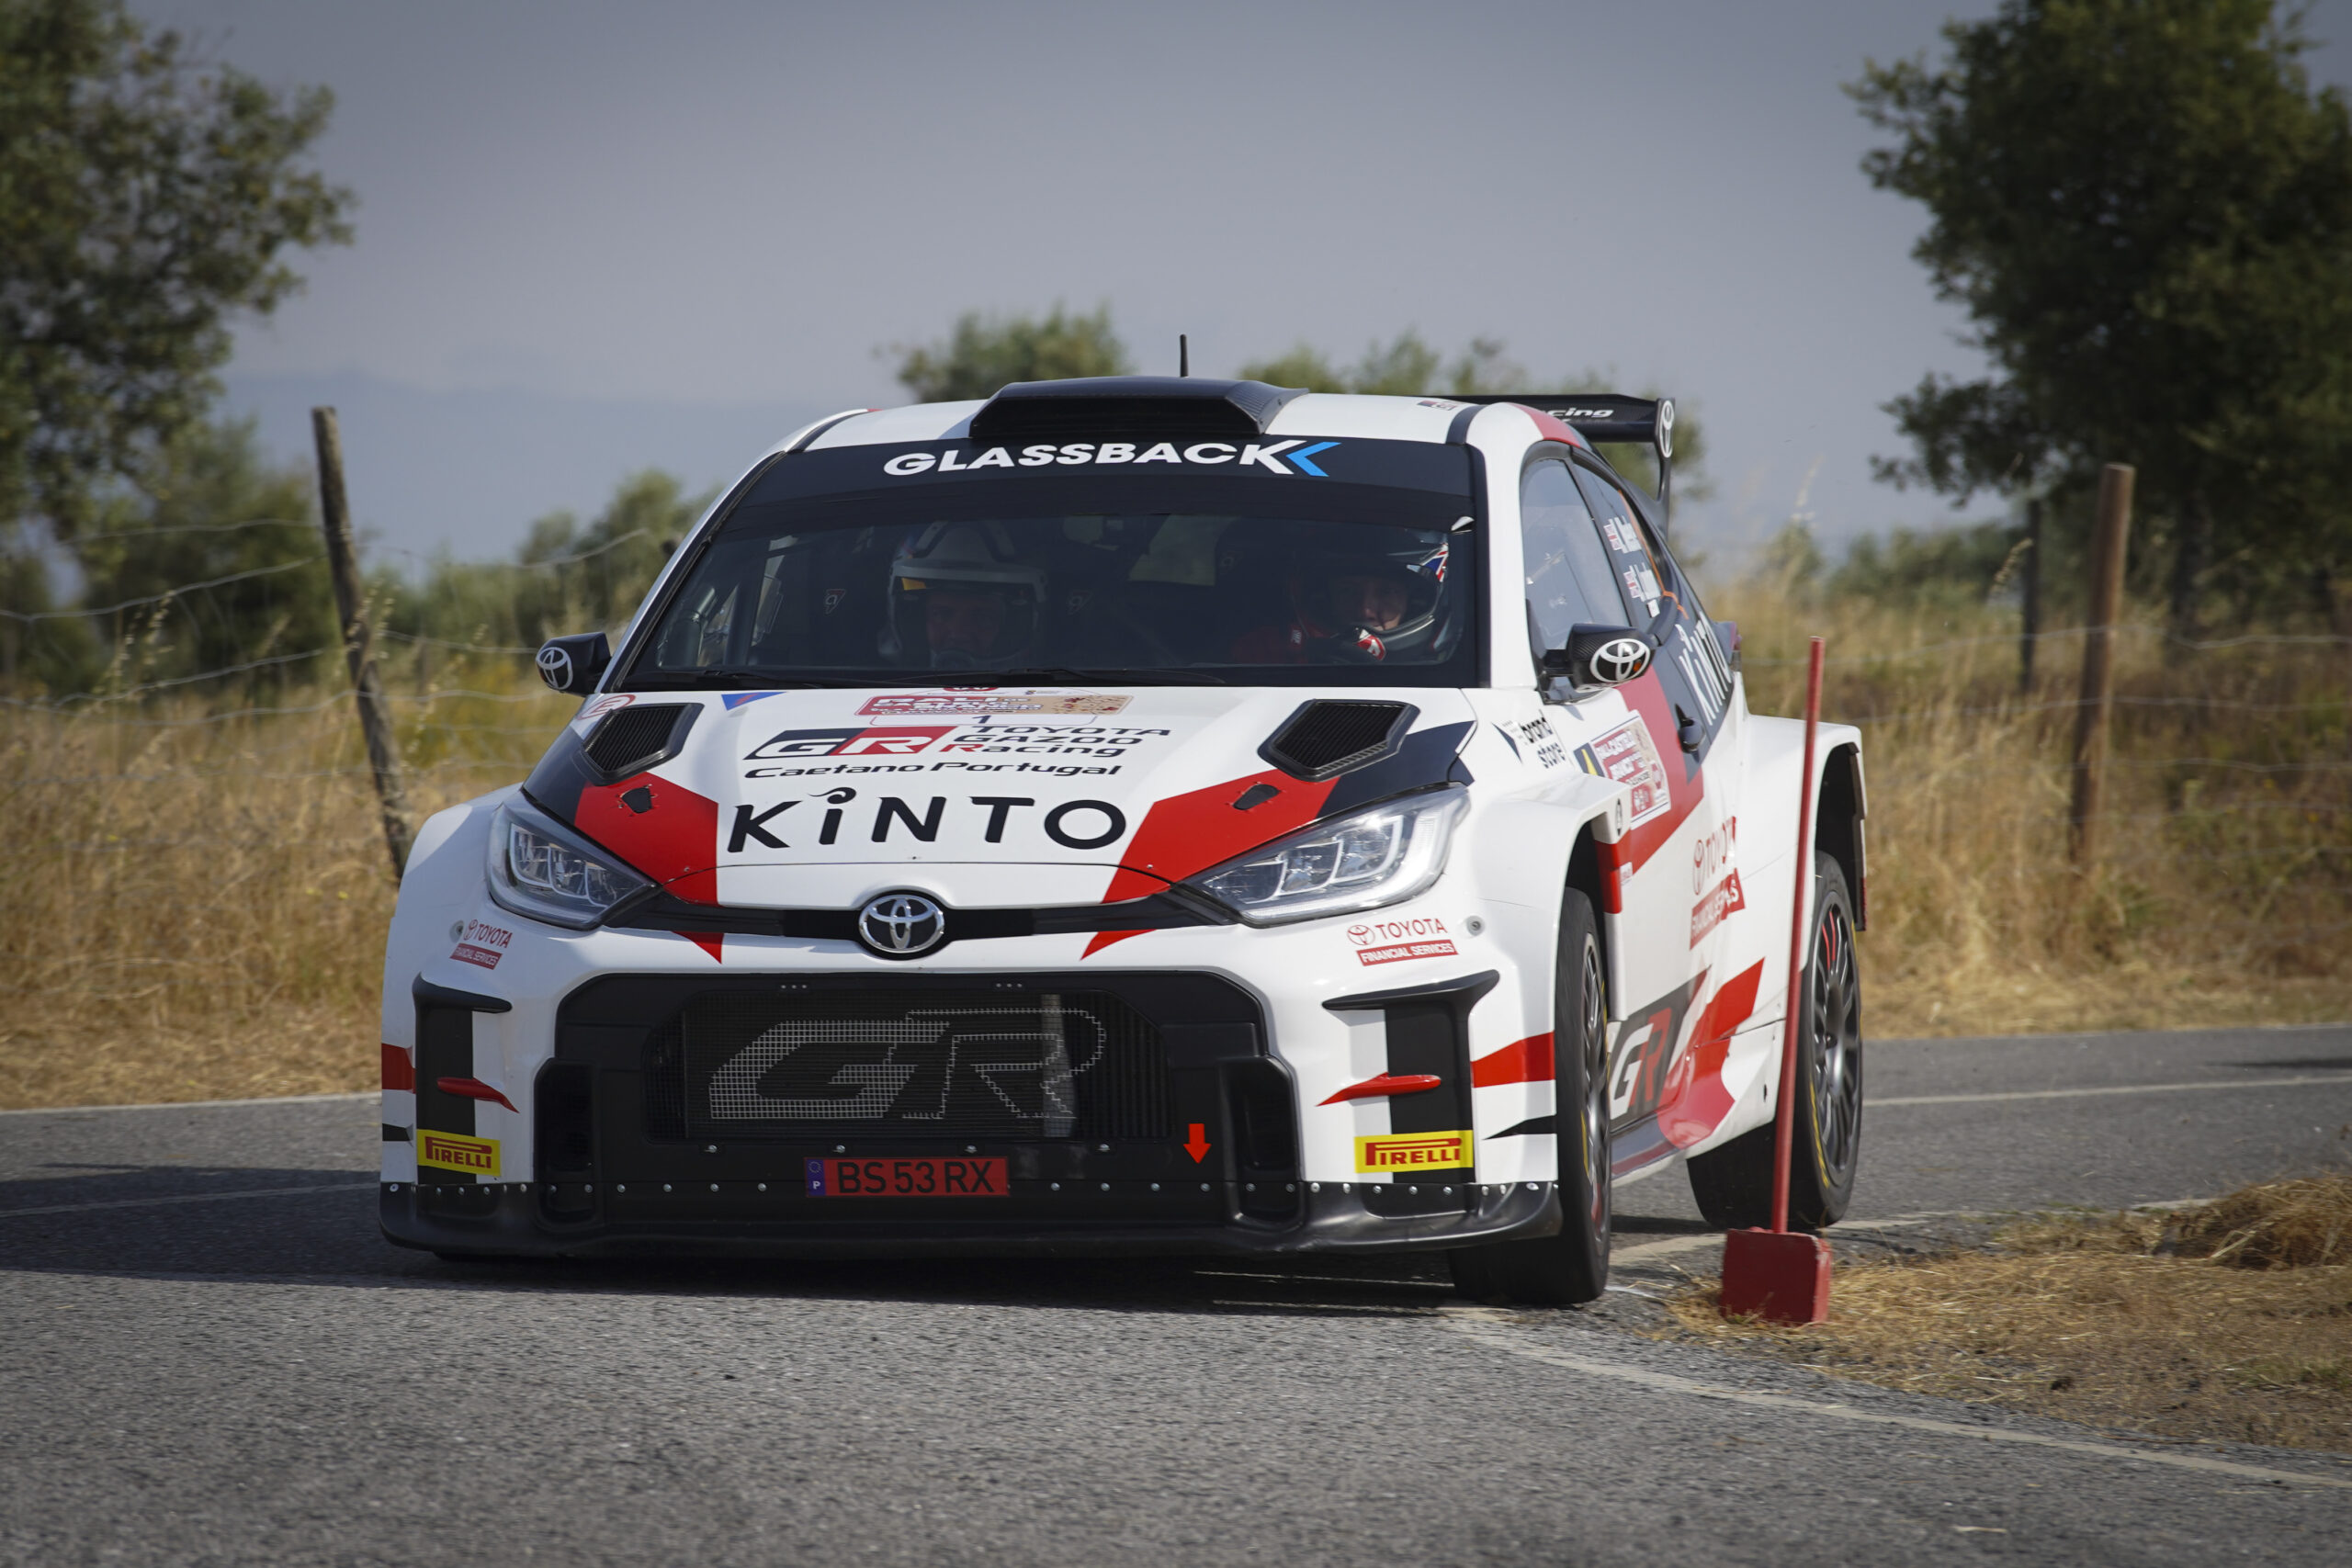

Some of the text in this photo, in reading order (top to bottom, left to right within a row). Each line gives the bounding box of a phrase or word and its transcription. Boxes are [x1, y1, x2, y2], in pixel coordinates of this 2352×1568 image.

[1546, 407, 1614, 418] cing
[884, 439, 1306, 475] GLASSBACK
[972, 715, 992, 724] 1
[953, 734, 1144, 746] GAZOO
[970, 725, 1172, 737] TOYOTA
[939, 743, 1128, 758] Racing
[744, 761, 1125, 779] Caetano Portugal
[474, 923, 514, 949] TOYOTA
[1374, 918, 1448, 940] TOYOTA
[1360, 943, 1454, 963] FINANCIAL SERVICES
[708, 1009, 1107, 1120] GR
[424, 1135, 493, 1170] PIRELLI
[1364, 1137, 1463, 1167] PIRELLI
[812, 1180, 820, 1190] P
[837, 1160, 996, 1194] BS 53 RX
